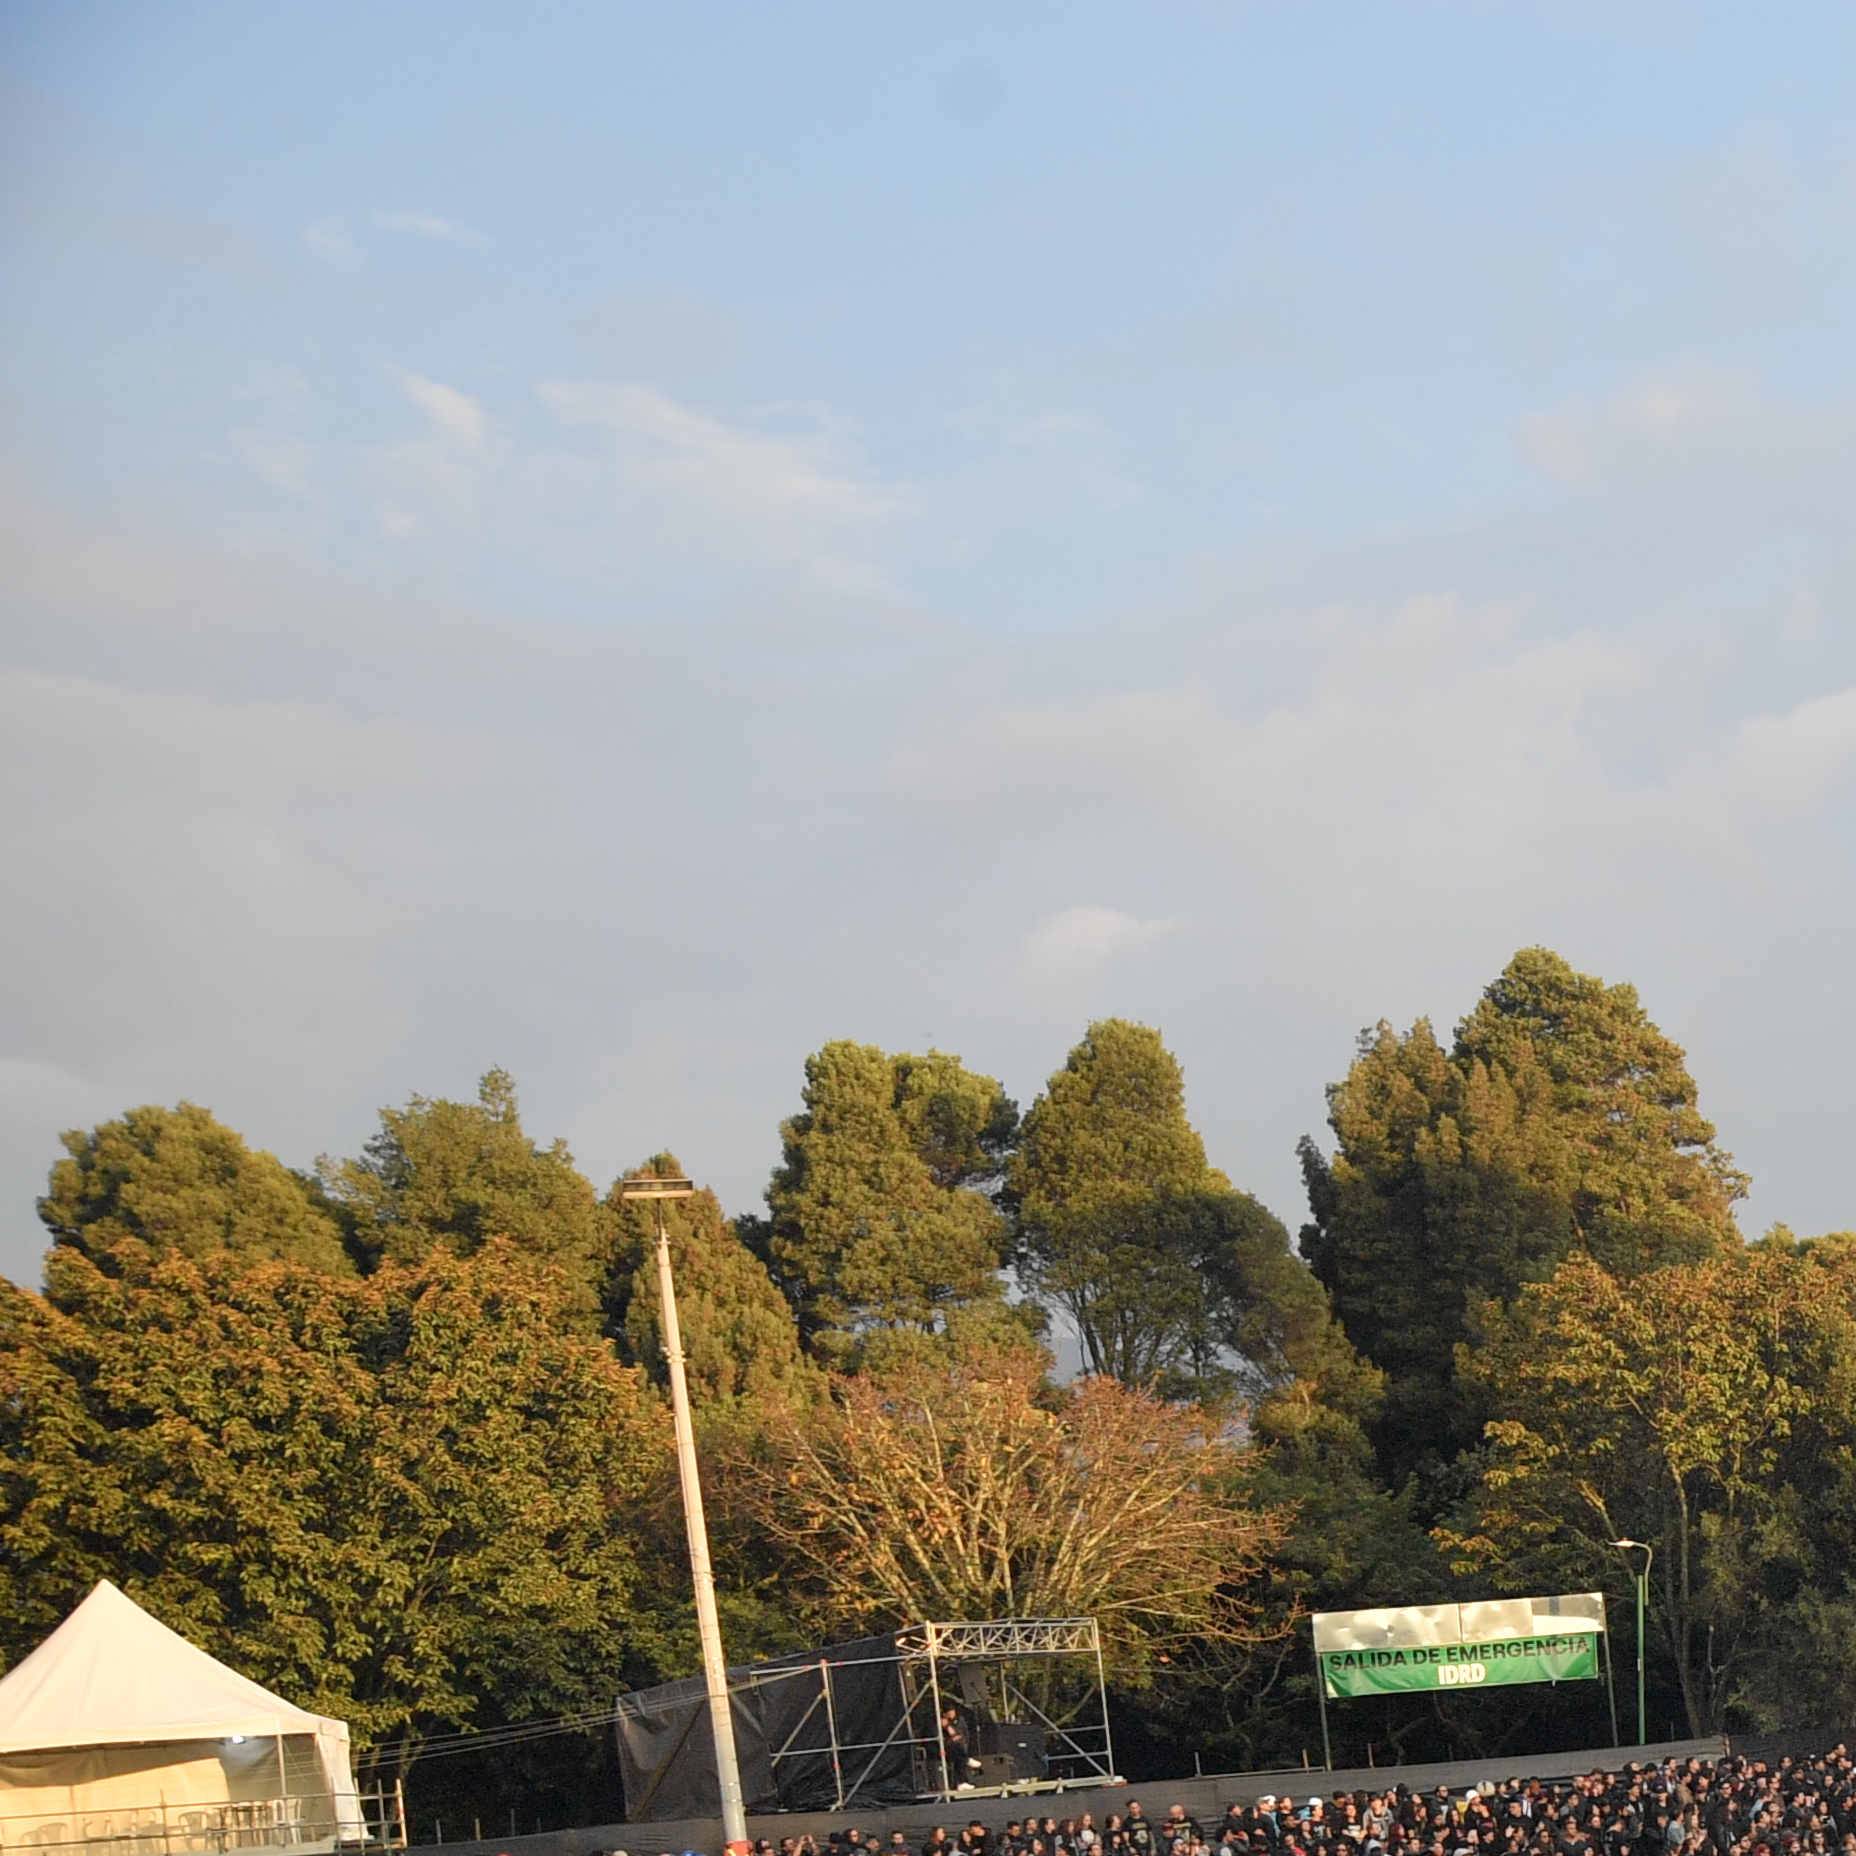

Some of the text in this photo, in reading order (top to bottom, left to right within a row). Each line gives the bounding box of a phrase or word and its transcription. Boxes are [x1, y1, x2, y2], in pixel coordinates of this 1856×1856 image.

[1328, 1637, 1591, 1671] SALIDA DE EMERGENCIA
[1437, 1662, 1486, 1686] IDRD
